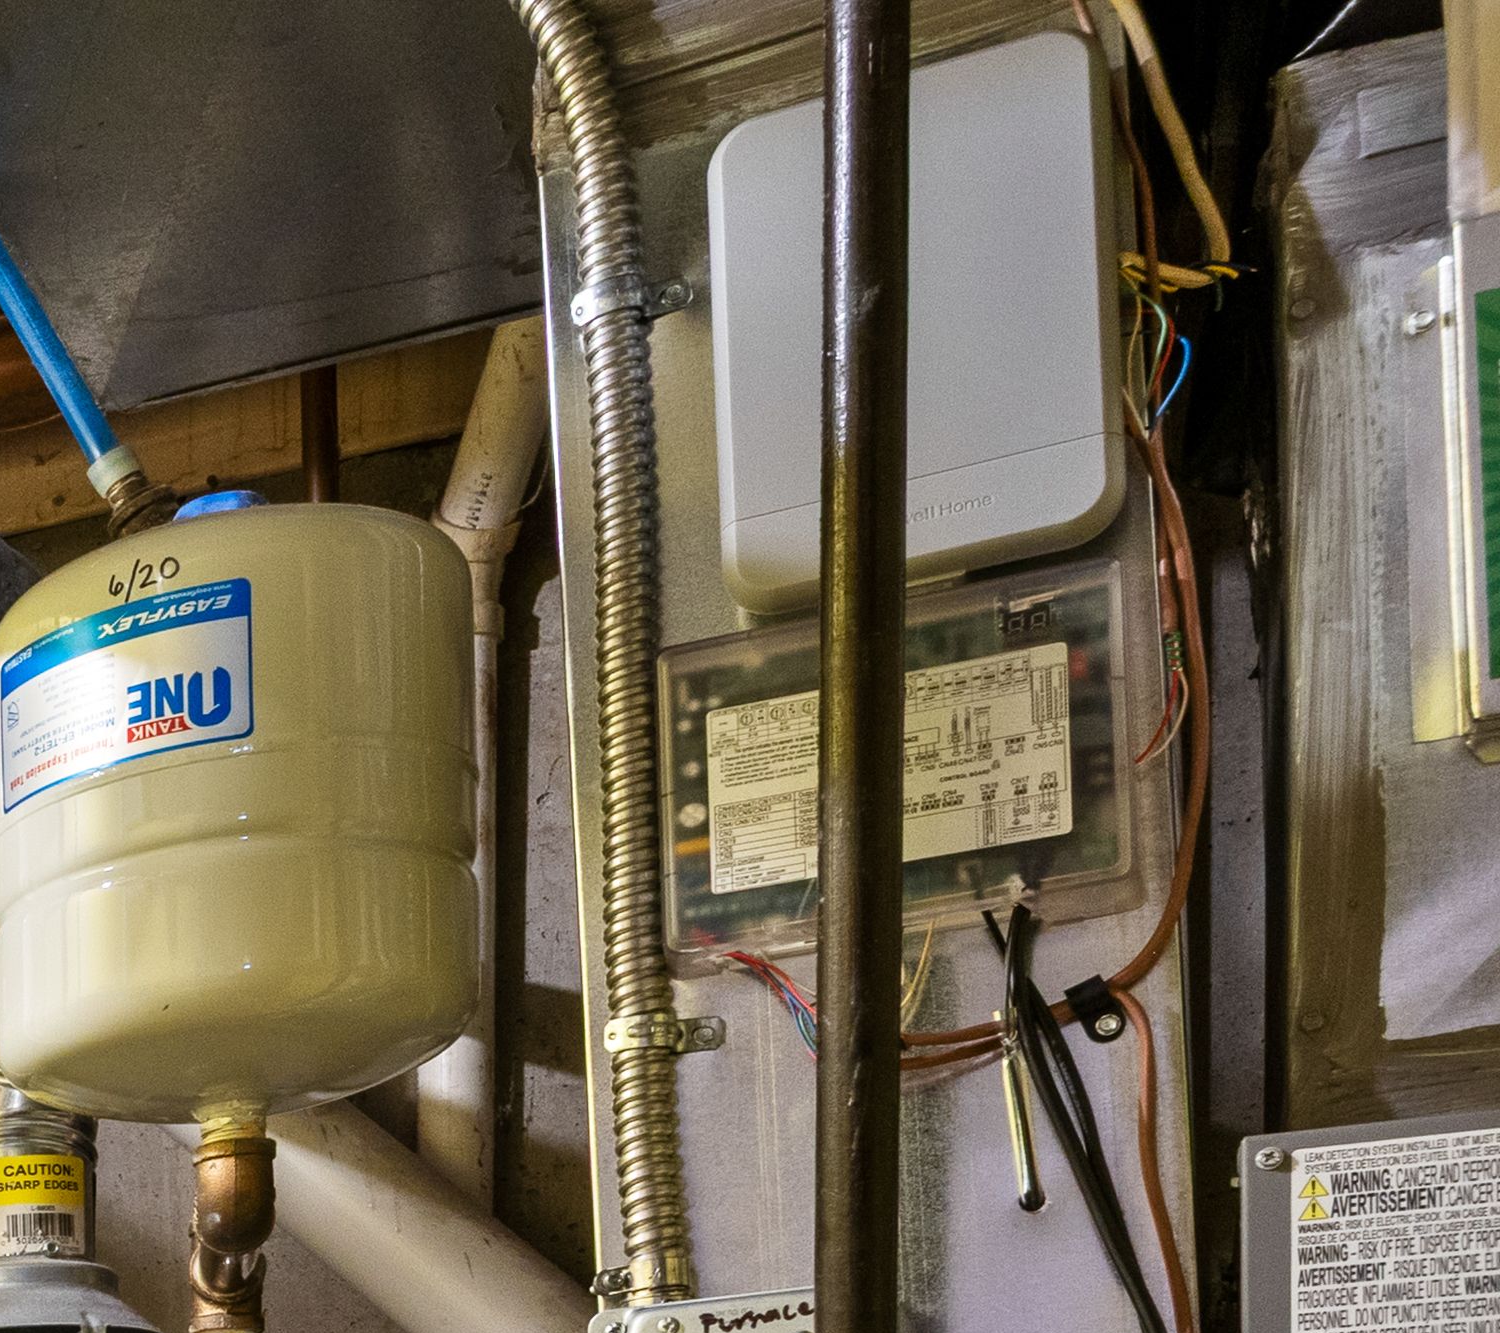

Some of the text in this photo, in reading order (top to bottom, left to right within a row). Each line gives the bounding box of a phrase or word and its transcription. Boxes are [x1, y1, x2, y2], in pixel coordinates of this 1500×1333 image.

[939, 494, 993, 517] Home
[109, 557, 179, 602] 6/20
[97, 593, 232, 640] EASYFLEX
[127, 666, 231, 727] ONE
[130, 716, 184, 739] TANK
[1305, 1134, 1494, 1163] LEAK DETECTION SYSTEM MUST
[4, 1163, 74, 1177] CAUTION:
[1331, 1163, 1459, 1195] WARNING: CANCER AND
[44, 1180, 78, 1191] EDGES
[1298, 1207, 1488, 1233] WARNING: RISK ELECTRIC CAN CAUSE
[1298, 1234, 1325, 1245] RISQUE
[1298, 1233, 1459, 1265] WARNING DISPOSE
[1298, 1262, 1387, 1287] AVERTISSEMENT
[1392, 1301, 1440, 1323] PUNCTURE
